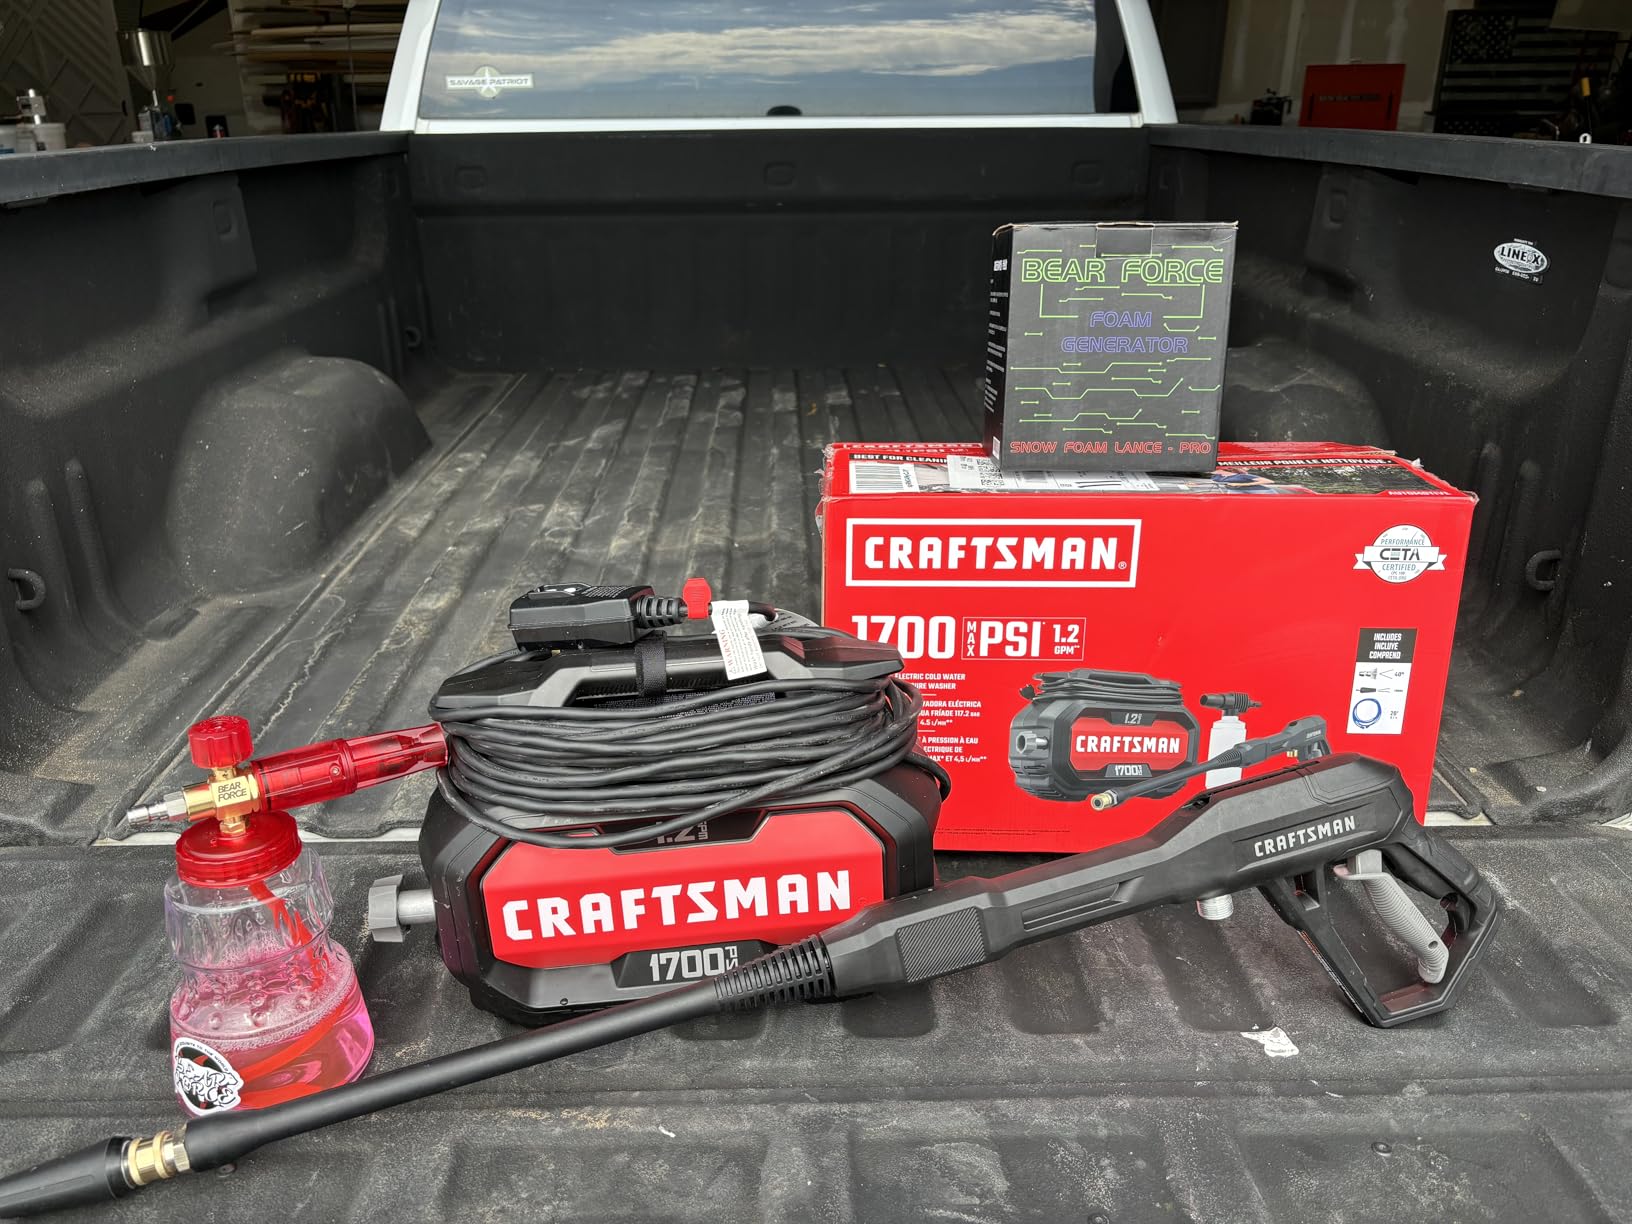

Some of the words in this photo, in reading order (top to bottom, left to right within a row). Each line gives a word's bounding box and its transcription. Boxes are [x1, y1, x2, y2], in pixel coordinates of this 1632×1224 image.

[489, 78, 529, 86] PATRIOT
[1021, 258, 1106, 283] BEAR
[1120, 258, 1224, 283] FORCE
[1090, 311, 1152, 328] FOAM
[1061, 337, 1189, 353] GENERATOR
[1010, 441, 1057, 454] SNOW
[1063, 441, 1108, 454] FOAM
[1114, 441, 1162, 454] LANCE
[1179, 441, 1212, 454] PRO
[1380, 538, 1425, 546] PERFORMANCE
[1379, 547, 1420, 561] CETA
[1382, 563, 1416, 571] CERTIFIED
[852, 615, 956, 659] 1700
[967, 621, 977, 656] MAX
[1053, 624, 1080, 643] 1.2
[1374, 633, 1402, 641] INCLUDES
[719, 629, 734, 667] WARNING
[1374, 642, 1398, 650] INCLUYE
[1369, 651, 1401, 659] COMPREND
[928, 682, 956, 690] WASHER
[948, 699, 981, 707] ELÉCTRICA
[1076, 735, 1180, 753] CRAFTSMAN
[1115, 765, 1139, 776] 1700
[218, 782, 241, 793] BEAR
[218, 788, 247, 802] FORCE
[1254, 815, 1356, 857] CRAFTSMAN
[502, 869, 851, 941] CRAFTSMAN
[649, 947, 726, 982] 1700
